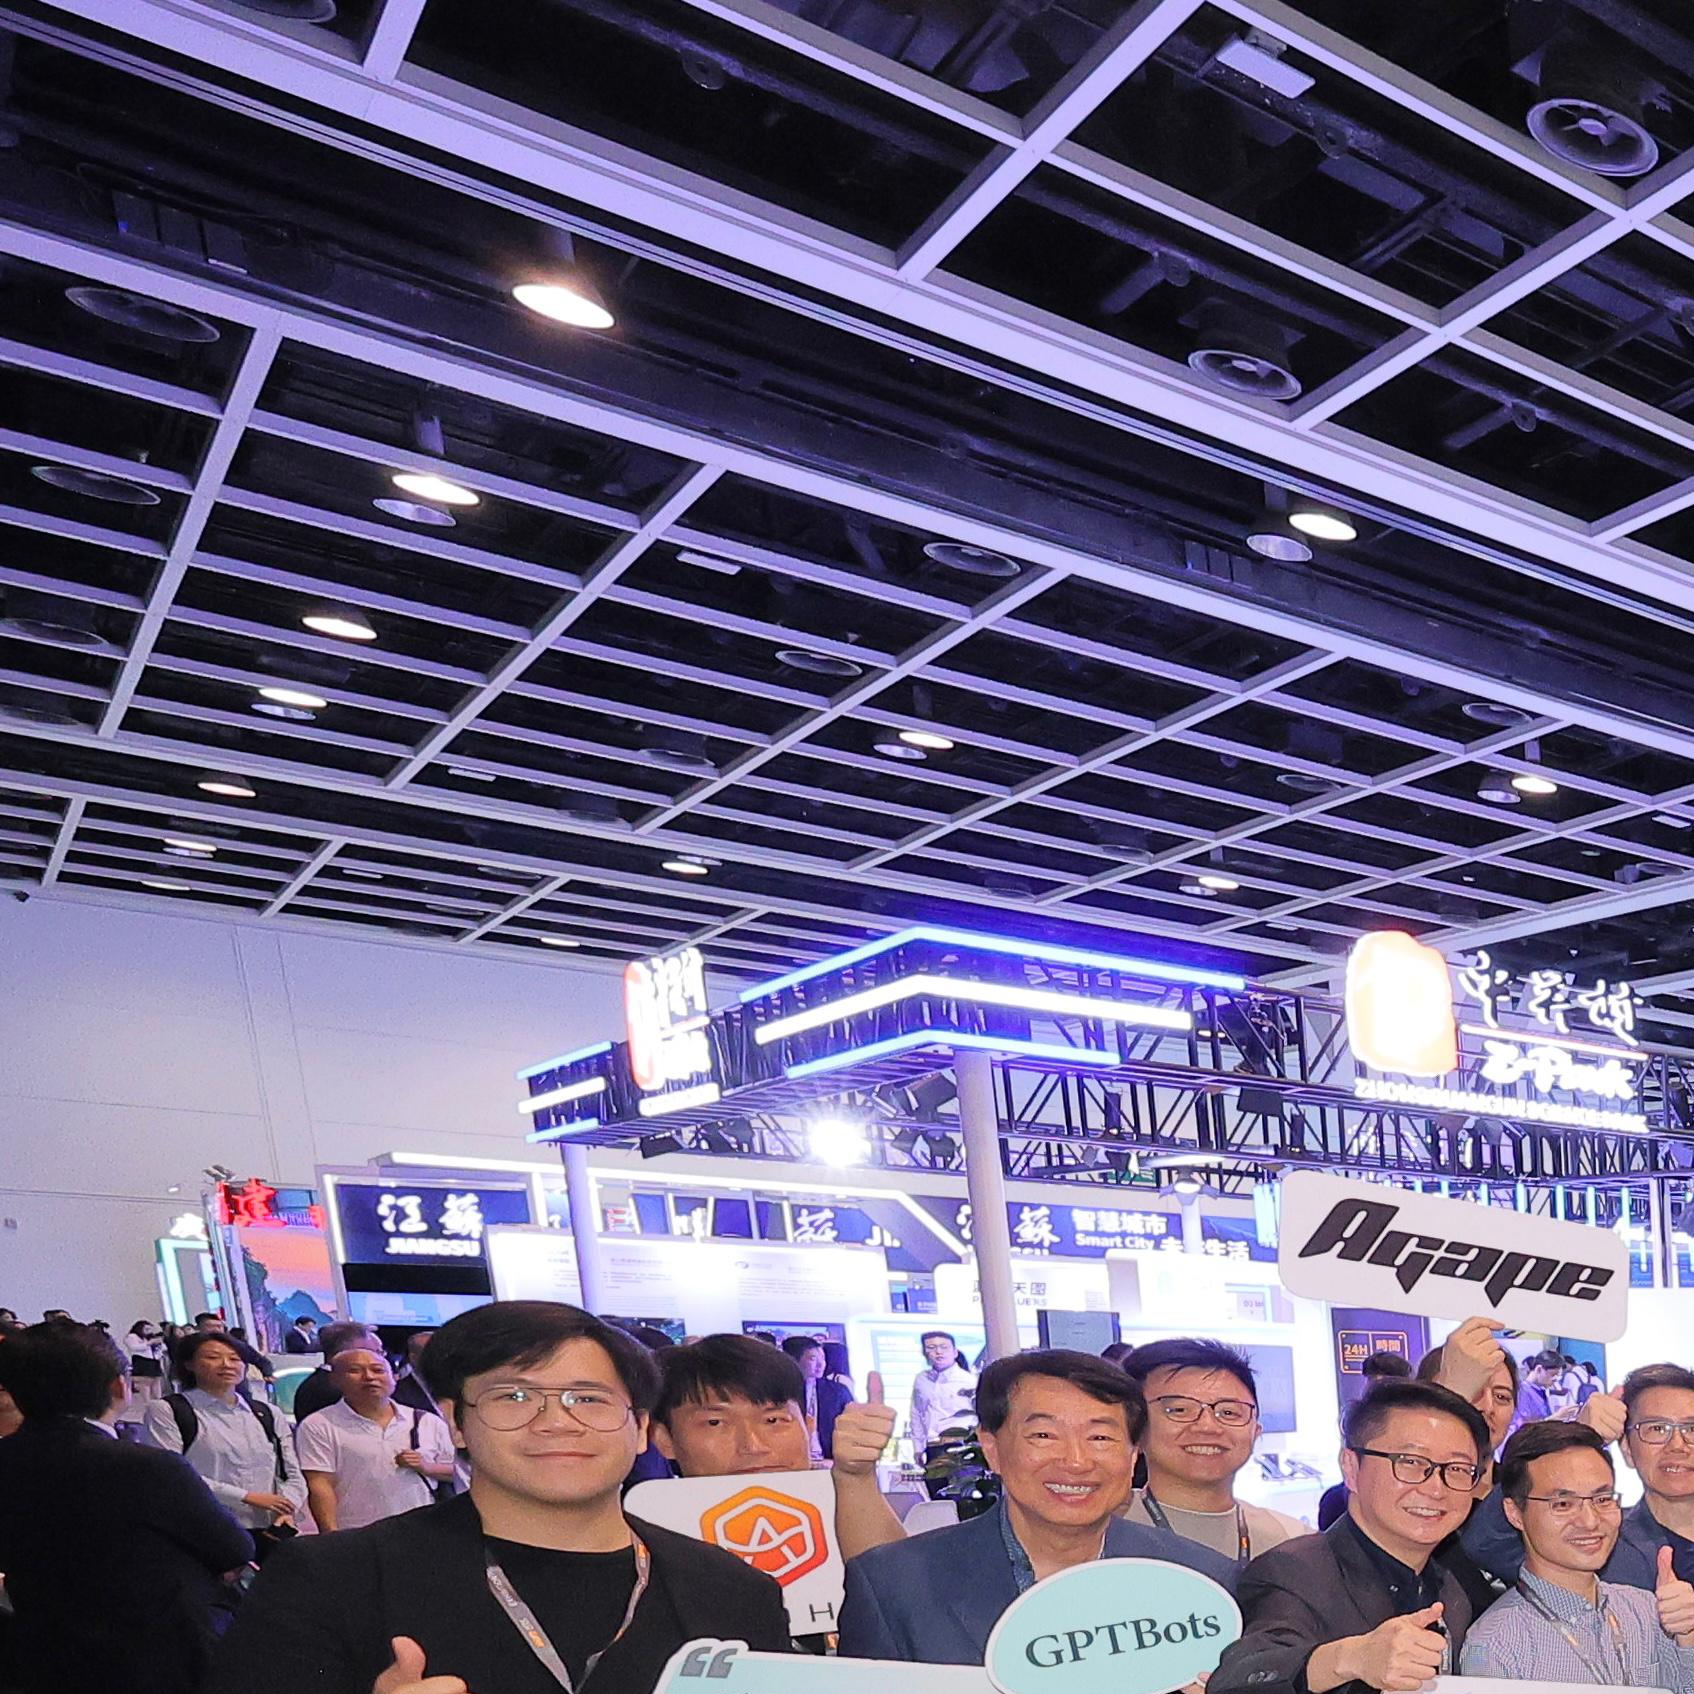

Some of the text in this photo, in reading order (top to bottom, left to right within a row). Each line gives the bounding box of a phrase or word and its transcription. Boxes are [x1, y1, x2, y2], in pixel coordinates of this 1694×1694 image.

[385, 1237, 480, 1257] JIANGSU
[1075, 1232, 1155, 1250] Smart City
[1025, 1611, 1222, 1669] GPTBots
